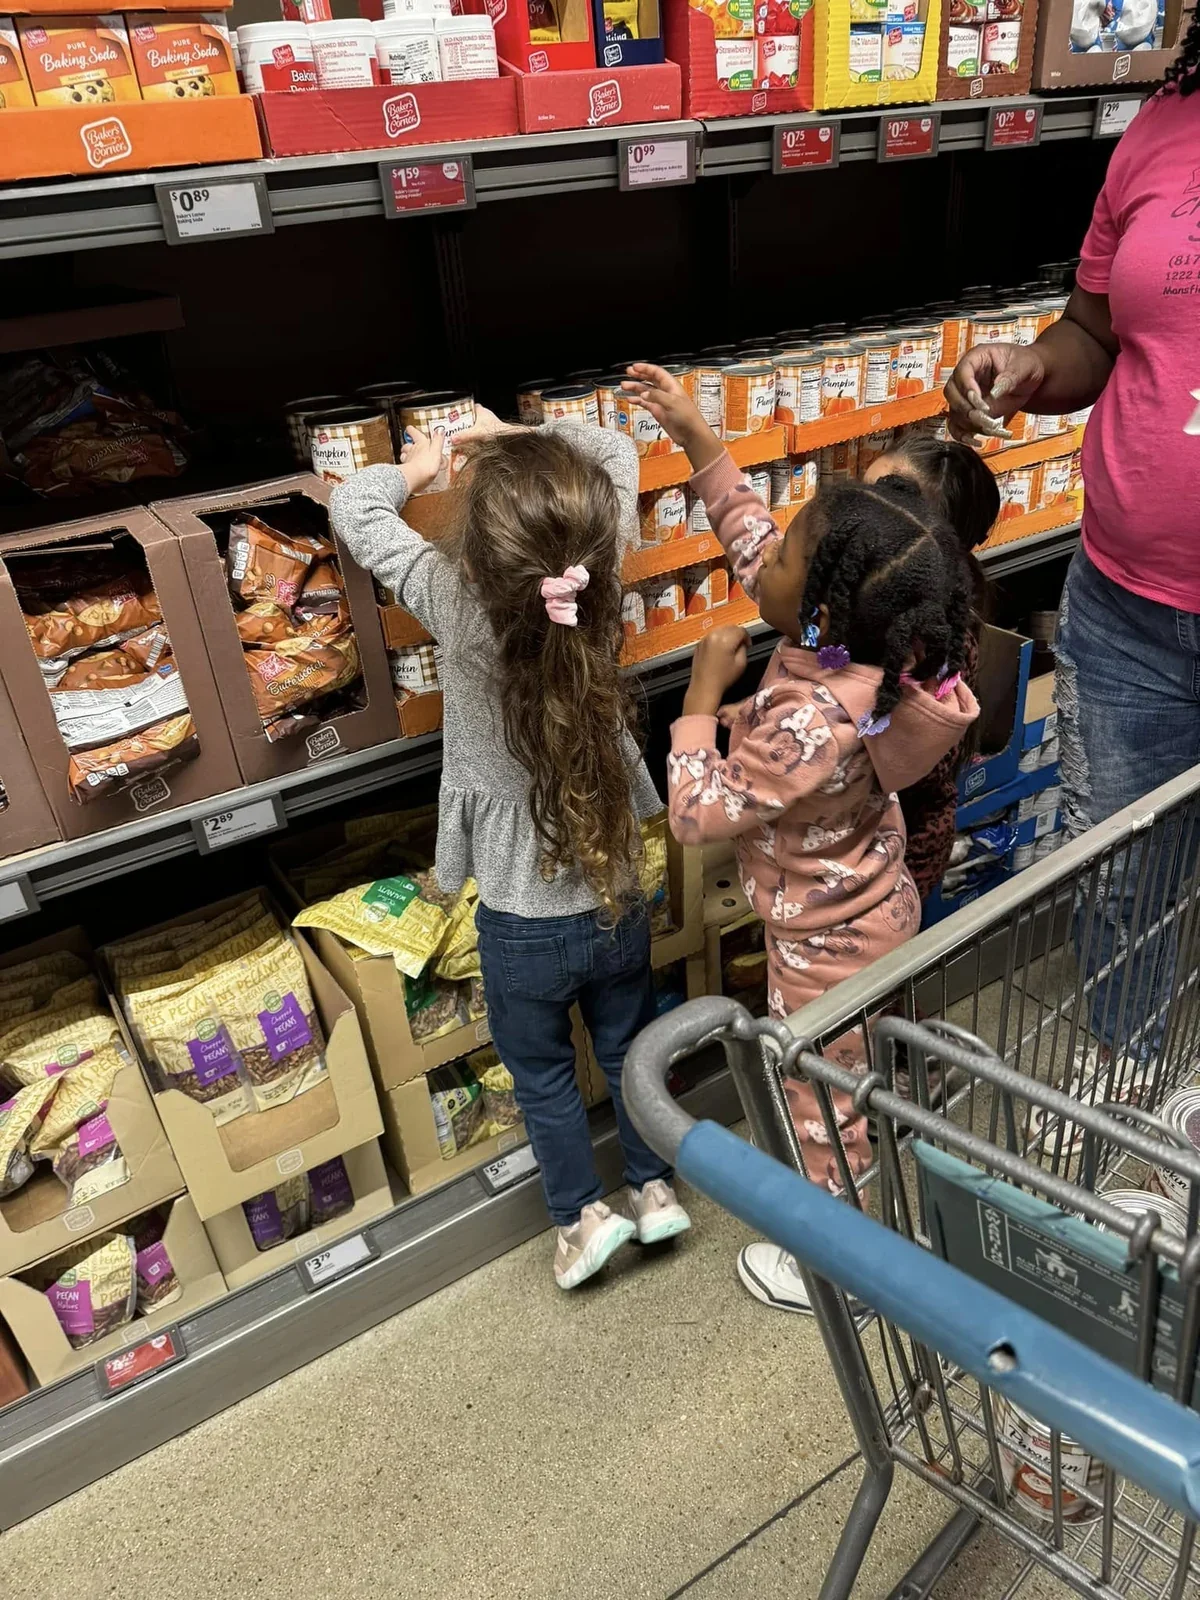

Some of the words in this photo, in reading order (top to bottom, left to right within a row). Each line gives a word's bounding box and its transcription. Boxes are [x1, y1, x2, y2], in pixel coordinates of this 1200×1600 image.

[172, 38, 191, 47] PURE
[953, 33, 977, 41] Chocolate
[66, 41, 87, 51] PURE
[718, 45, 752, 54] Strawberry
[39, 52, 90, 73] Baking
[88, 45, 118, 64] Soda
[147, 48, 192, 68] Baking
[191, 42, 219, 60] Soda
[593, 86, 617, 102] Baker's
[387, 100, 413, 117] Baker's
[594, 101, 618, 117] Corner
[390, 115, 415, 133] Corner
[87, 124, 120, 145] Baker's
[93, 142, 124, 162] Corner
[1166, 270, 1193, 281] 1222
[1162, 284, 1200, 295] Mansfi
[822, 376, 856, 389] Pumpkin
[311, 443, 349, 460] Pumpkin
[266, 660, 326, 696] Butterscotch
[310, 730, 333, 747] Baker's
[236, 957, 281, 993] PECANS
[271, 1007, 293, 1025] Chopped
[274, 1015, 298, 1035] PECANS
[203, 1044, 229, 1062] PECANS
[56, 1290, 79, 1301] PECAN
